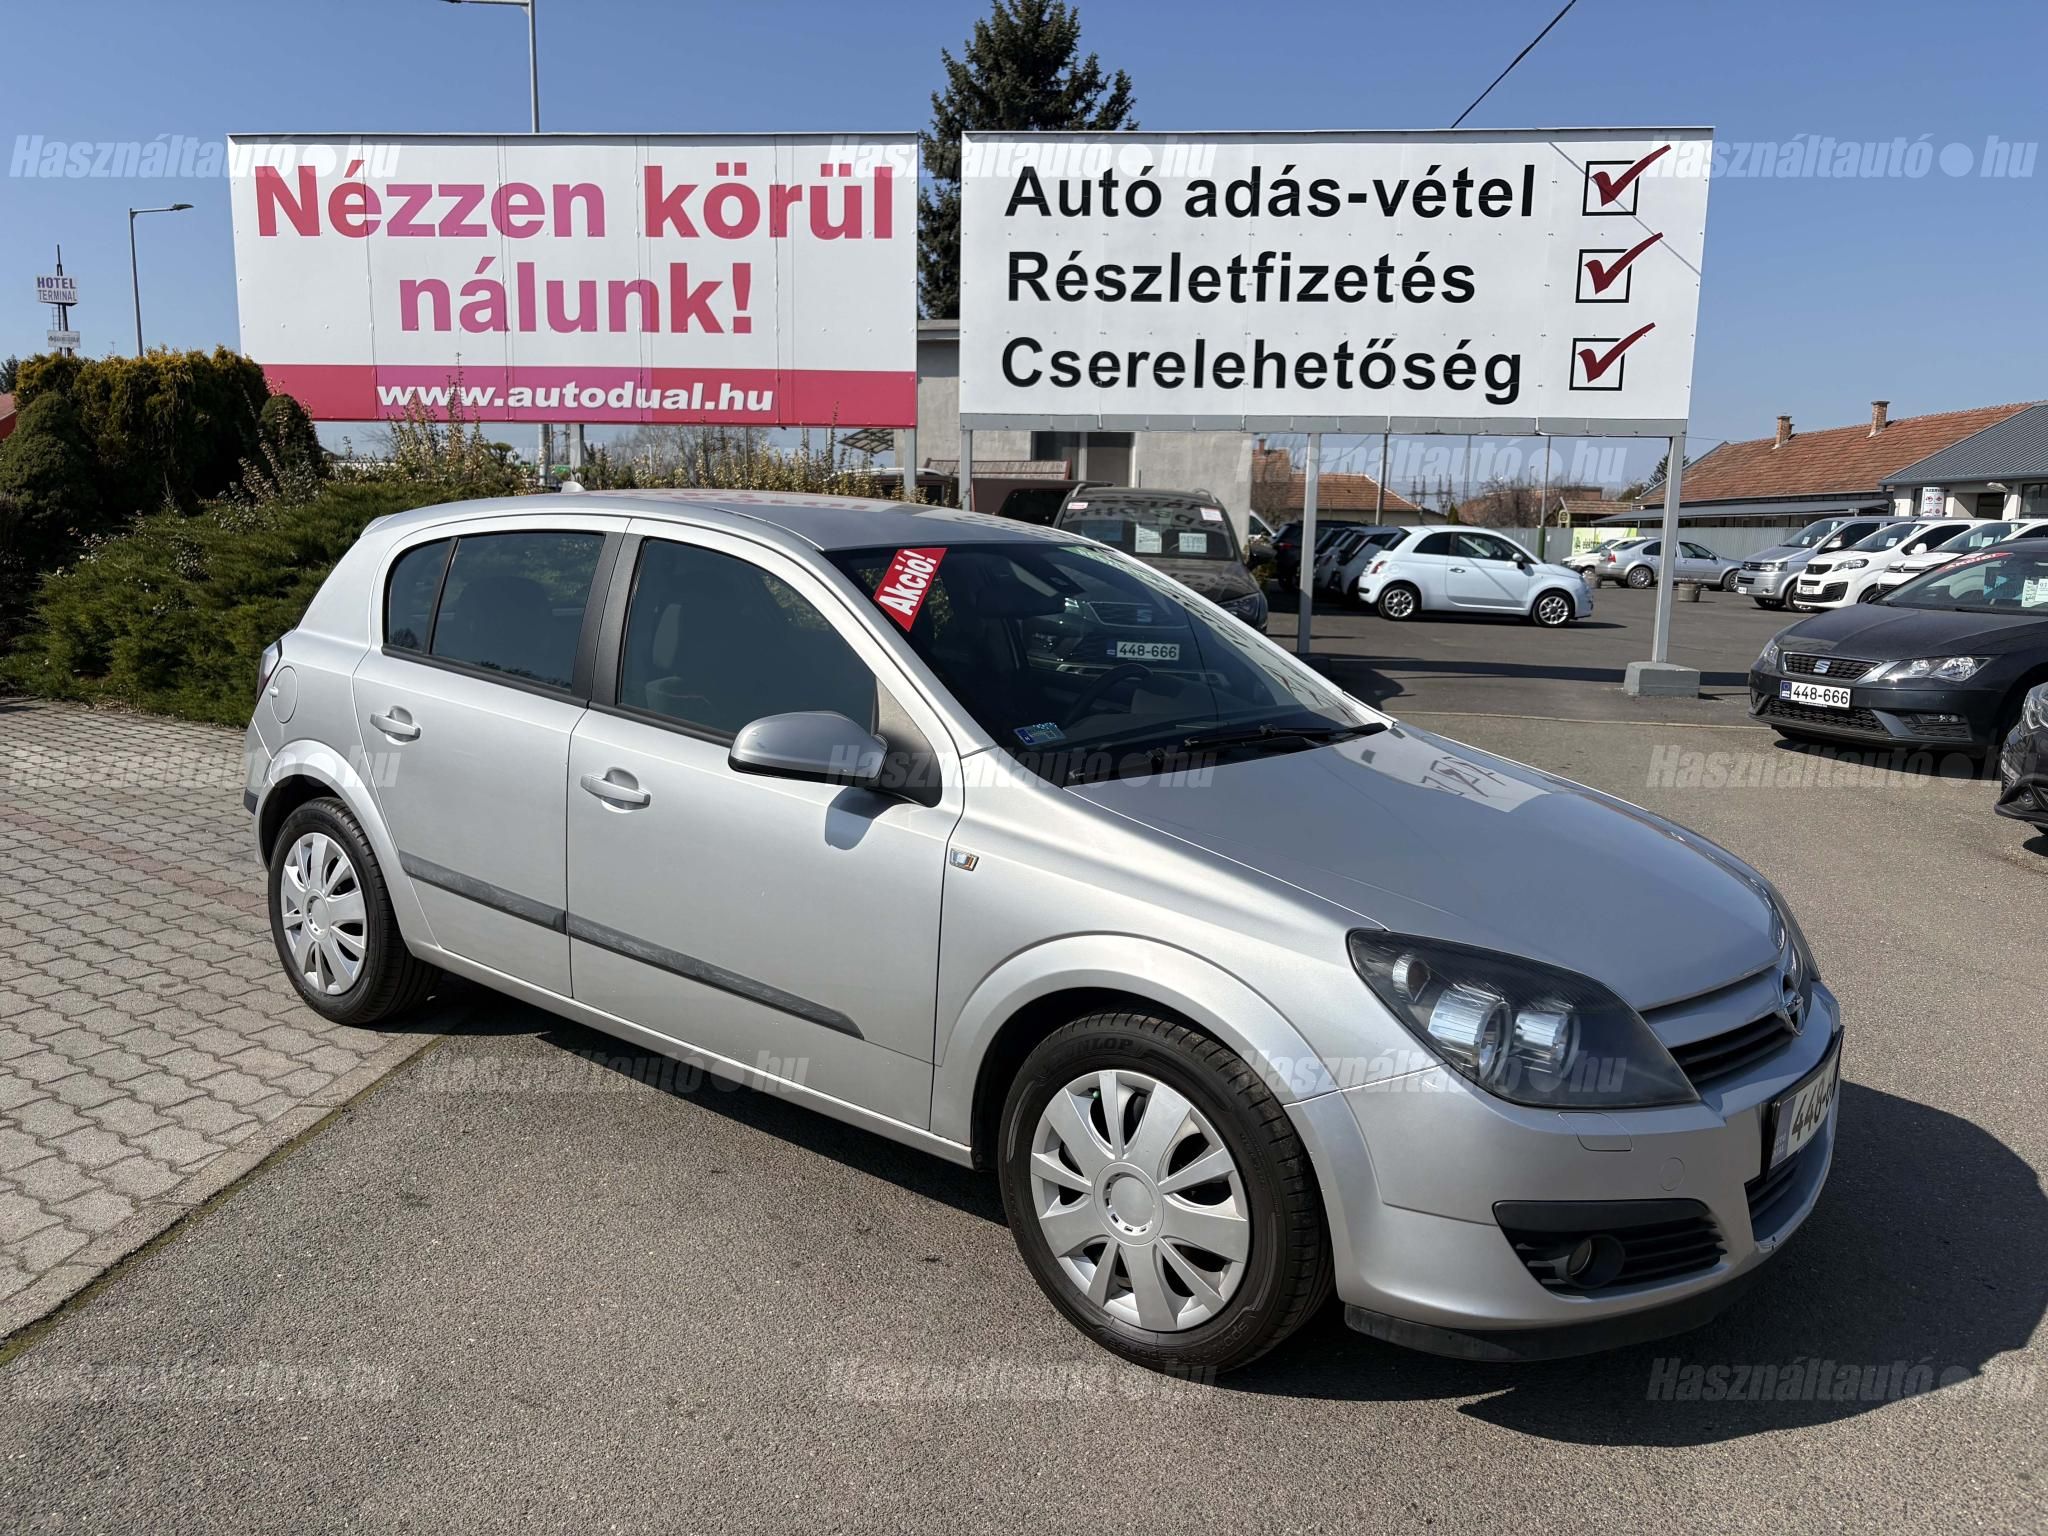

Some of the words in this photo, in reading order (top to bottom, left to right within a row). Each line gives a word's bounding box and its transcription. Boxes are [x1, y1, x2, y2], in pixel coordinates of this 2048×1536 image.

[255, 160, 605, 239] Nézzen
[644, 163, 894, 241] körül
[1004, 165, 1162, 218] Autó
[1184, 164, 1535, 219] adás-vétel
[36, 276, 77, 289] HOTEL
[37, 289, 78, 302] TERMINAL
[399, 256, 753, 335] nálunk!
[1008, 250, 1475, 304] Részletfizetés
[376, 380, 774, 412] www.autodual.hu
[1002, 336, 1521, 406] Cserelehetőség
[878, 549, 937, 616] Akció!
[1119, 644, 1178, 660] 448-666
[1792, 684, 1850, 705] 448-666
